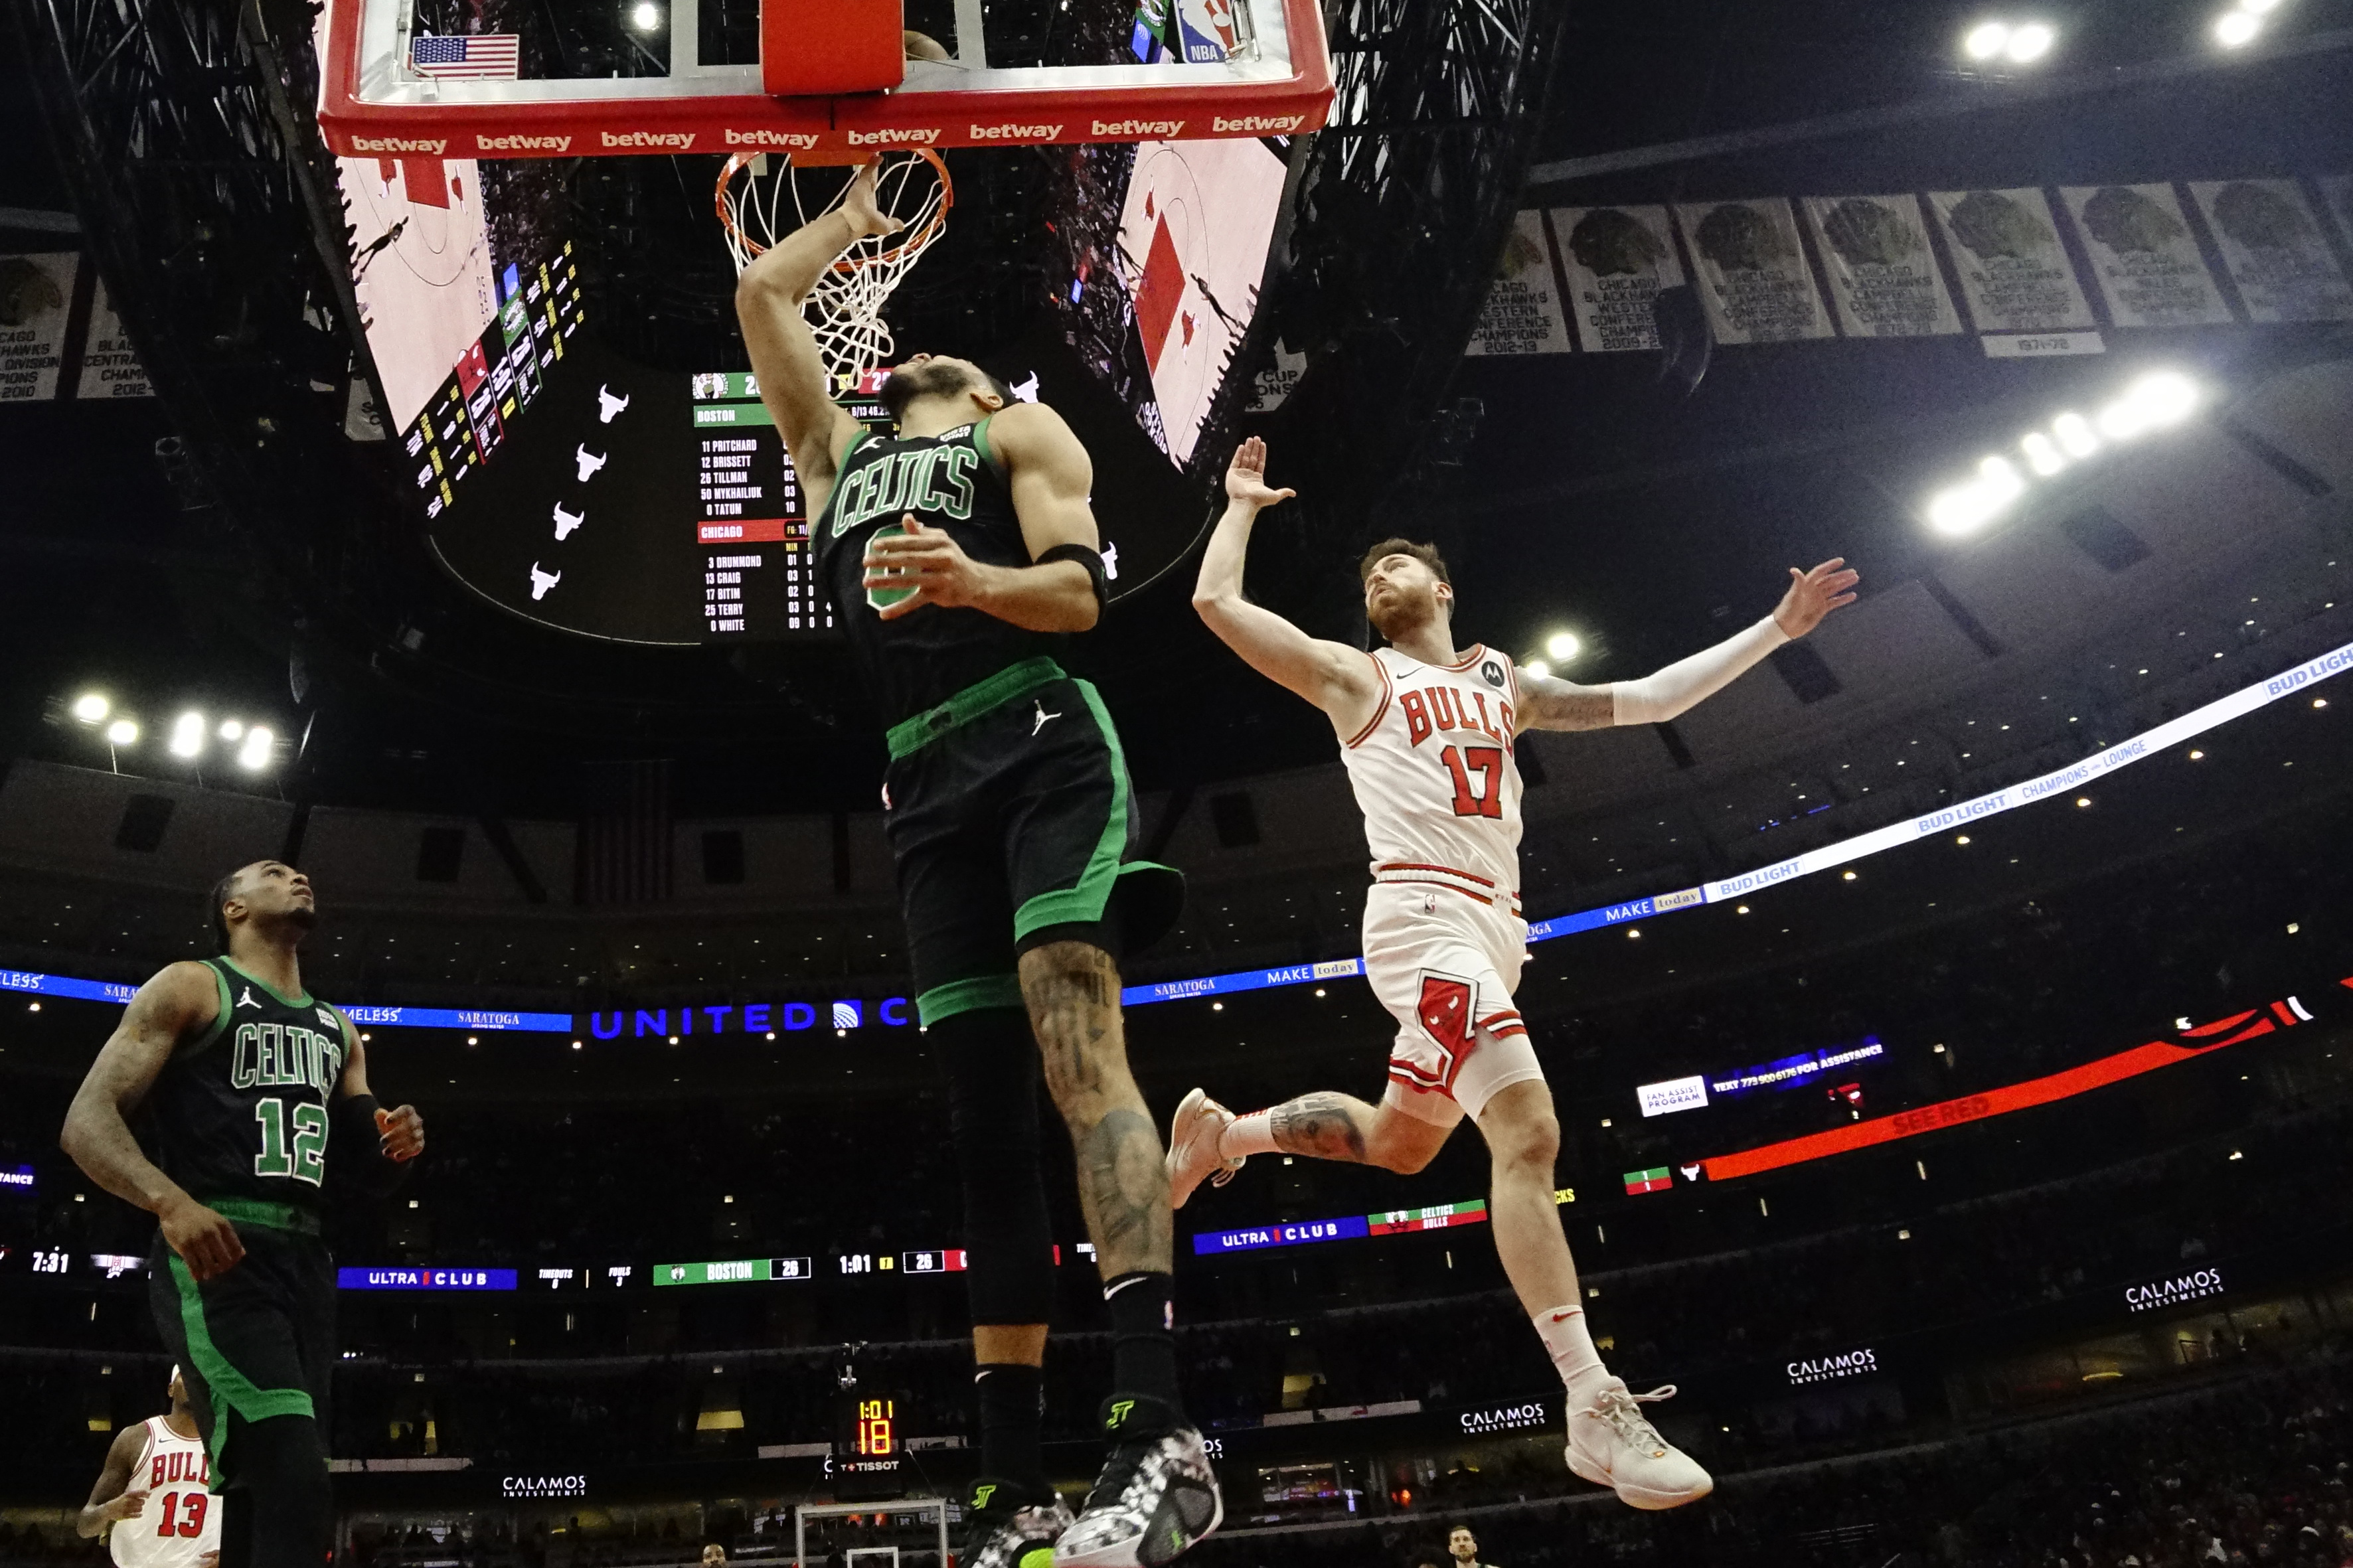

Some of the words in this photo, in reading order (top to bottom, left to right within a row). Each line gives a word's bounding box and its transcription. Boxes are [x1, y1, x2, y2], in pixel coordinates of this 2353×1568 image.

[1190, 44, 1218, 60] NBA
[970, 123, 1063, 140] betway
[1092, 119, 1185, 137] betway
[1212, 115, 1305, 132] betway
[351, 135, 447, 155] betway
[476, 134, 571, 151] betway
[602, 131, 695, 149] betway
[724, 129, 819, 149] betway
[848, 128, 941, 145] betway
[556, 277, 567, 295] 11
[560, 300, 572, 316] 2
[1483, 305, 1538, 317] ESTERN
[1477, 316, 1553, 330] NFERENCE
[1589, 314, 1655, 326] CONFERE
[1, 343, 50, 356] HAWKS
[511, 335, 530, 366] 26
[84, 354, 137, 368] CENTRA
[491, 356, 513, 400] 1:01
[1262, 370, 1298, 383] CUP
[113, 383, 155, 396] 2012-
[471, 387, 491, 419] 26
[697, 410, 735, 422] BOSTON
[852, 406, 867, 418] 6/13
[443, 420, 456, 440] 10
[702, 441, 710, 452] 11
[712, 439, 757, 452] PRITCHARD
[701, 457, 710, 468] 12
[713, 455, 751, 468] BRISSETT
[700, 473, 711, 484] 26
[713, 471, 748, 484] TILLMAN
[784, 470, 795, 481] 02
[701, 489, 712, 500] 50
[714, 487, 762, 500] MYKHAILIUK
[785, 485, 795, 497] 03
[831, 444, 979, 538] CELTICS
[427, 495, 443, 519] 2/4
[706, 504, 712, 515] 0
[714, 503, 742, 515] TATUM
[785, 501, 795, 512] 10
[701, 526, 743, 538] CHICAGO
[786, 542, 798, 552] MIN
[708, 557, 714, 569] 3
[716, 555, 762, 568] DRUMMOND
[787, 554, 797, 566] 01
[807, 554, 813, 565] 0
[705, 573, 714, 584] 13
[717, 572, 741, 584] CRAIG
[787, 570, 798, 582] 03
[808, 570, 813, 580] 1
[706, 589, 715, 600] 17
[718, 588, 740, 600] BITIM
[788, 586, 799, 597] 02
[808, 585, 813, 597] 0
[705, 604, 716, 616] 25
[718, 603, 743, 615] TERRY
[788, 601, 799, 613] 03
[809, 601, 814, 612] 0
[826, 601, 831, 612] 4
[710, 620, 716, 631] 0
[718, 619, 745, 631] WHITE
[789, 617, 800, 629] 09
[809, 617, 815, 628] 0
[827, 615, 833, 627] 0
[2267, 669, 2308, 696] BUD
[2311, 646, 2353, 678] LIGH
[1400, 686, 1514, 758] BULLS
[2022, 766, 2089, 799] CHAMPIONS
[2103, 739, 2148, 768] LOUNGE
[1441, 745, 1502, 820] 17
[1918, 811, 1954, 834] BUD
[1956, 795, 2006, 823] LIGHT
[1720, 876, 1753, 896] BUD
[1755, 861, 1800, 885] LIGHT
[1606, 901, 1651, 921] MAKE
[1659, 892, 1697, 908] today
[1267, 967, 1309, 984] MAKE
[1318, 962, 1355, 976] today
[1155, 979, 1215, 996] SARATOGA
[343, 1008, 400, 1022] MELESS
[457, 1012, 519, 1026] SARATOGA
[591, 1001, 817, 1040] UNITED
[232, 1023, 341, 1107] CELTICS
[1713, 1080, 1740, 1093] TEXT
[1797, 1062, 1819, 1075] FOR
[1820, 1044, 1883, 1069] ASSISTANCE
[1647, 1092, 1664, 1102] FAN
[1668, 1085, 1698, 1097] ASSIST
[1649, 1093, 1701, 1109] PROGRAM
[1893, 1107, 1937, 1134] SEE
[1939, 1097, 1990, 1122] RED
[255, 1097, 329, 1188] 12
[0, 1173, 33, 1184] TANCE
[1421, 1205, 1454, 1219] CELTICS
[1423, 1217, 1448, 1229] BULLS
[1222, 1233, 1269, 1247] ULTRA
[1285, 1223, 1337, 1240] CLUB
[1076, 1243, 1095, 1253] TIME
[33, 1252, 68, 1273] 7:31
[783, 1261, 799, 1277] 26
[840, 1254, 871, 1274] 1:01
[916, 1254, 932, 1269] 26
[368, 1272, 418, 1285] ULTRA
[435, 1273, 487, 1285] CLUB
[538, 1269, 573, 1279] TIMEOUTS
[609, 1267, 631, 1277] FOULS
[706, 1262, 752, 1281] BOSTON
[616, 1277, 623, 1287] 3
[2126, 1268, 2220, 1303] CALAMOS
[2130, 1285, 2224, 1312] INVESTMENTS
[1787, 1348, 1875, 1377] CALAMOS
[1791, 1364, 1878, 1385] INVESTMENTS
[860, 1400, 892, 1420] 1:01
[1461, 1403, 1544, 1427] CALAMOS
[1463, 1417, 1546, 1434] INVESTMENTS
[860, 1420, 890, 1455] 18
[149, 1452, 210, 1490] BULL
[856, 1460, 900, 1472] TISSOT
[503, 1475, 586, 1490] CALAMOS
[503, 1489, 585, 1498] INVESTMENTS
[157, 1491, 208, 1538] 13
